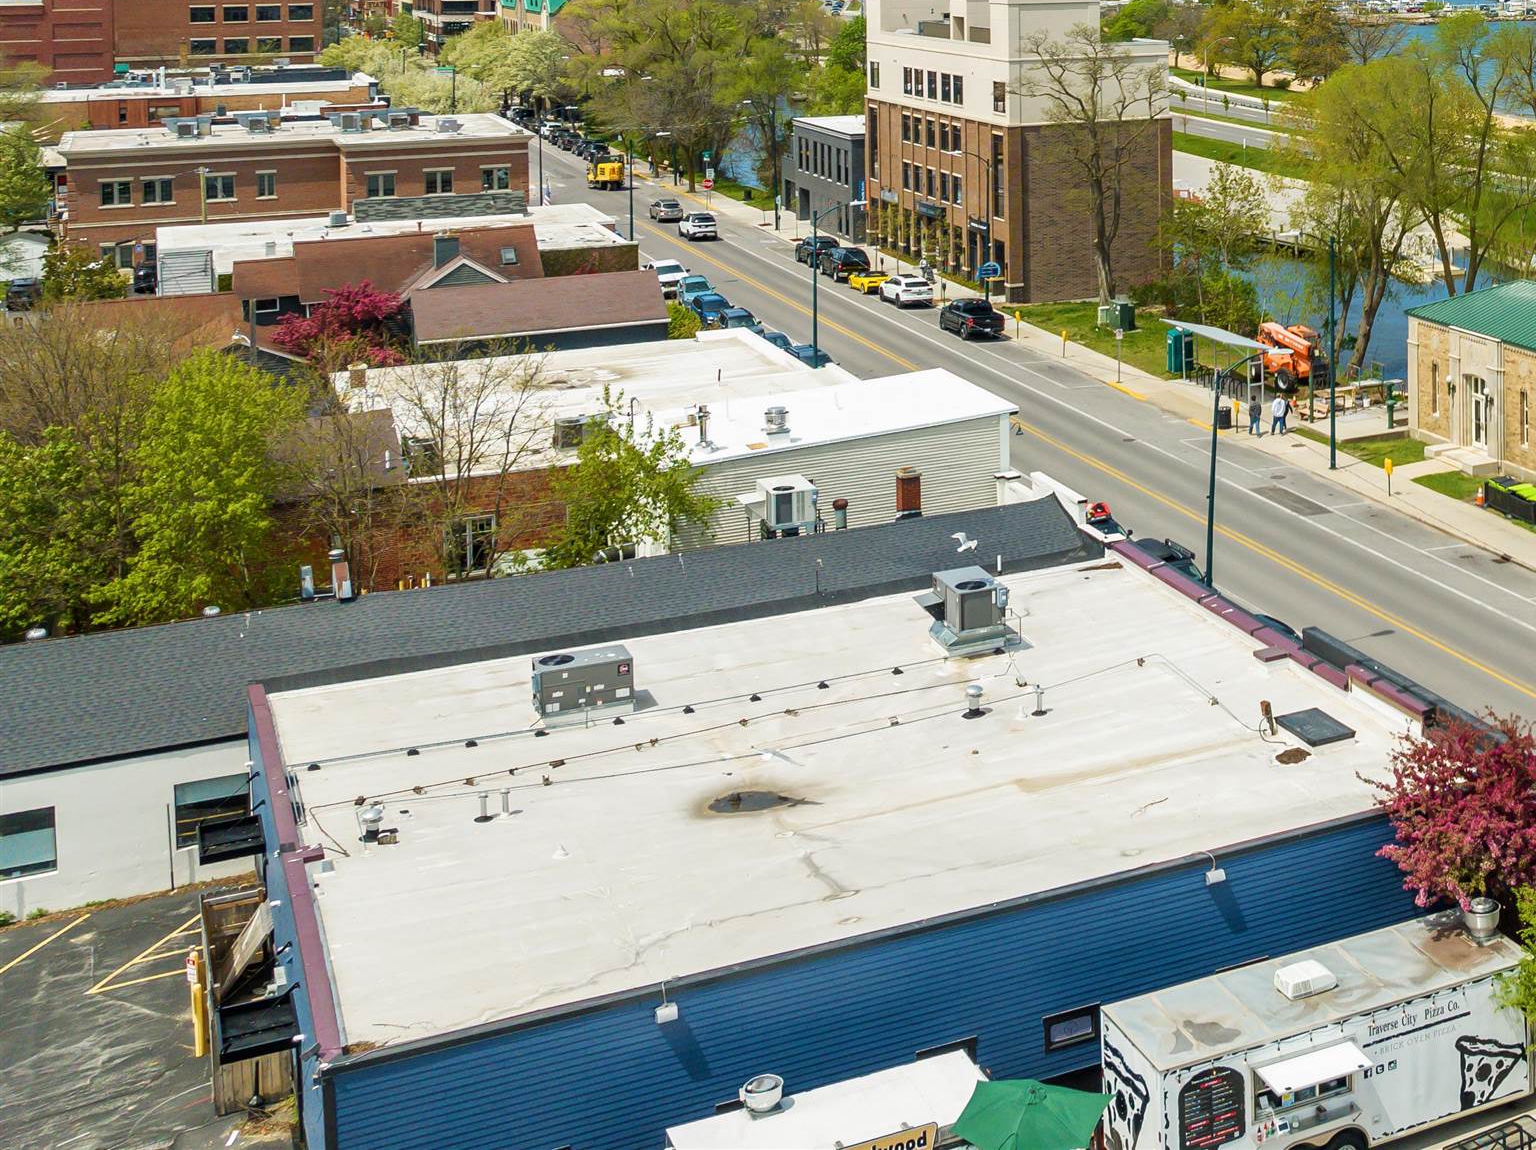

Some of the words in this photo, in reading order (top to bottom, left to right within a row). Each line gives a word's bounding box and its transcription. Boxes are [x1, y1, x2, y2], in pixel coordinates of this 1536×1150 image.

[1368, 1019, 1399, 1037] Traverse
[1402, 1014, 1418, 1027] City
[1424, 1007, 1445, 1020] Pizza
[1448, 1000, 1460, 1012] Co.
[1380, 1042, 1405, 1055] BRICK
[1407, 1033, 1432, 1046] OVEN
[1433, 1025, 1457, 1039] PIZZA
